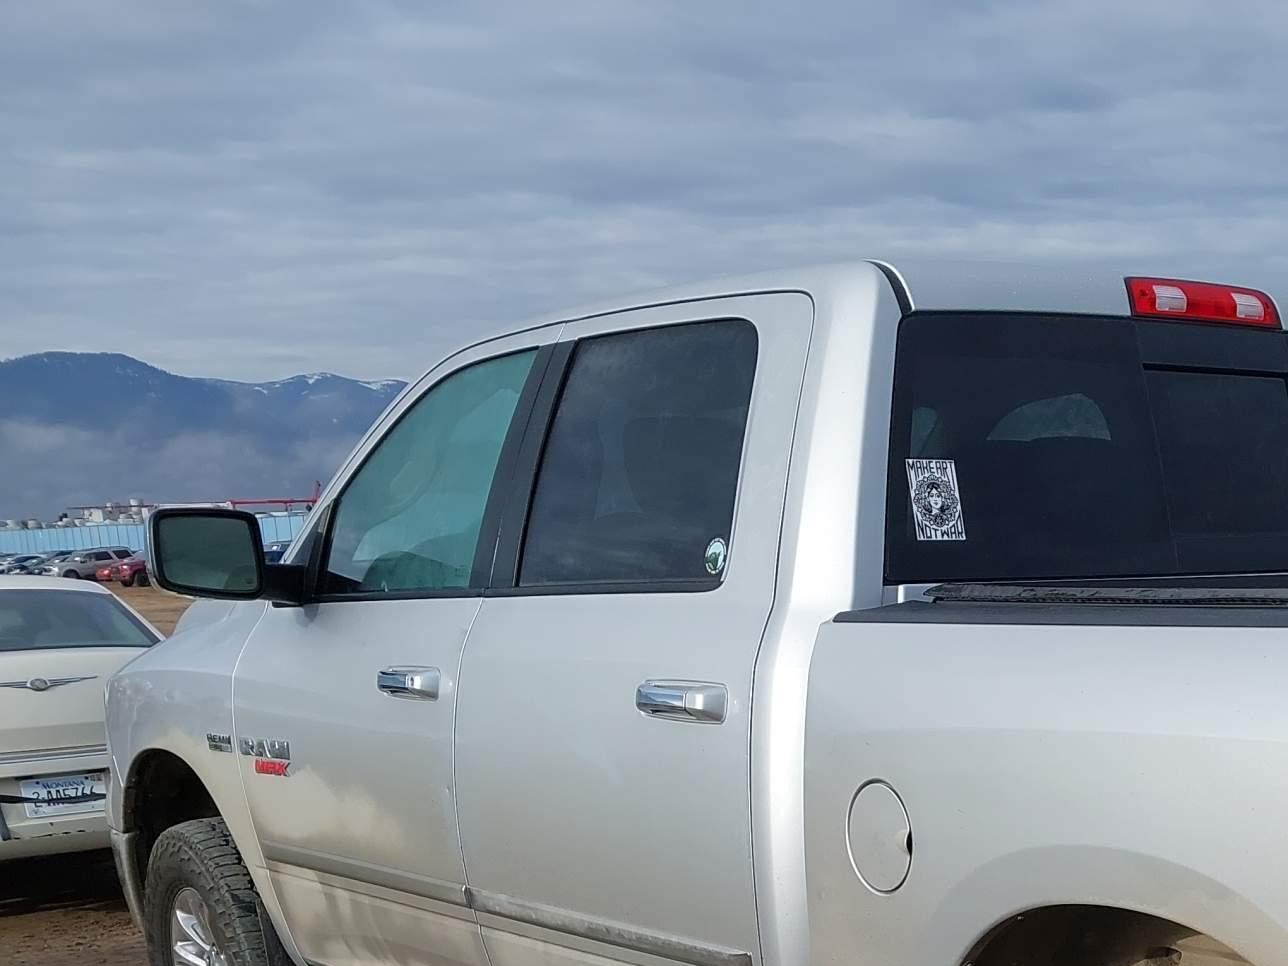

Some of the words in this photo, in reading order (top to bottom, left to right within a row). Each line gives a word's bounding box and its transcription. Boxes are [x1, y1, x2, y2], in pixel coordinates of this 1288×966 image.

[907, 460, 935, 490] MAKE
[935, 461, 956, 491] ART
[916, 511, 941, 539] NOT
[940, 510, 964, 539] WAR
